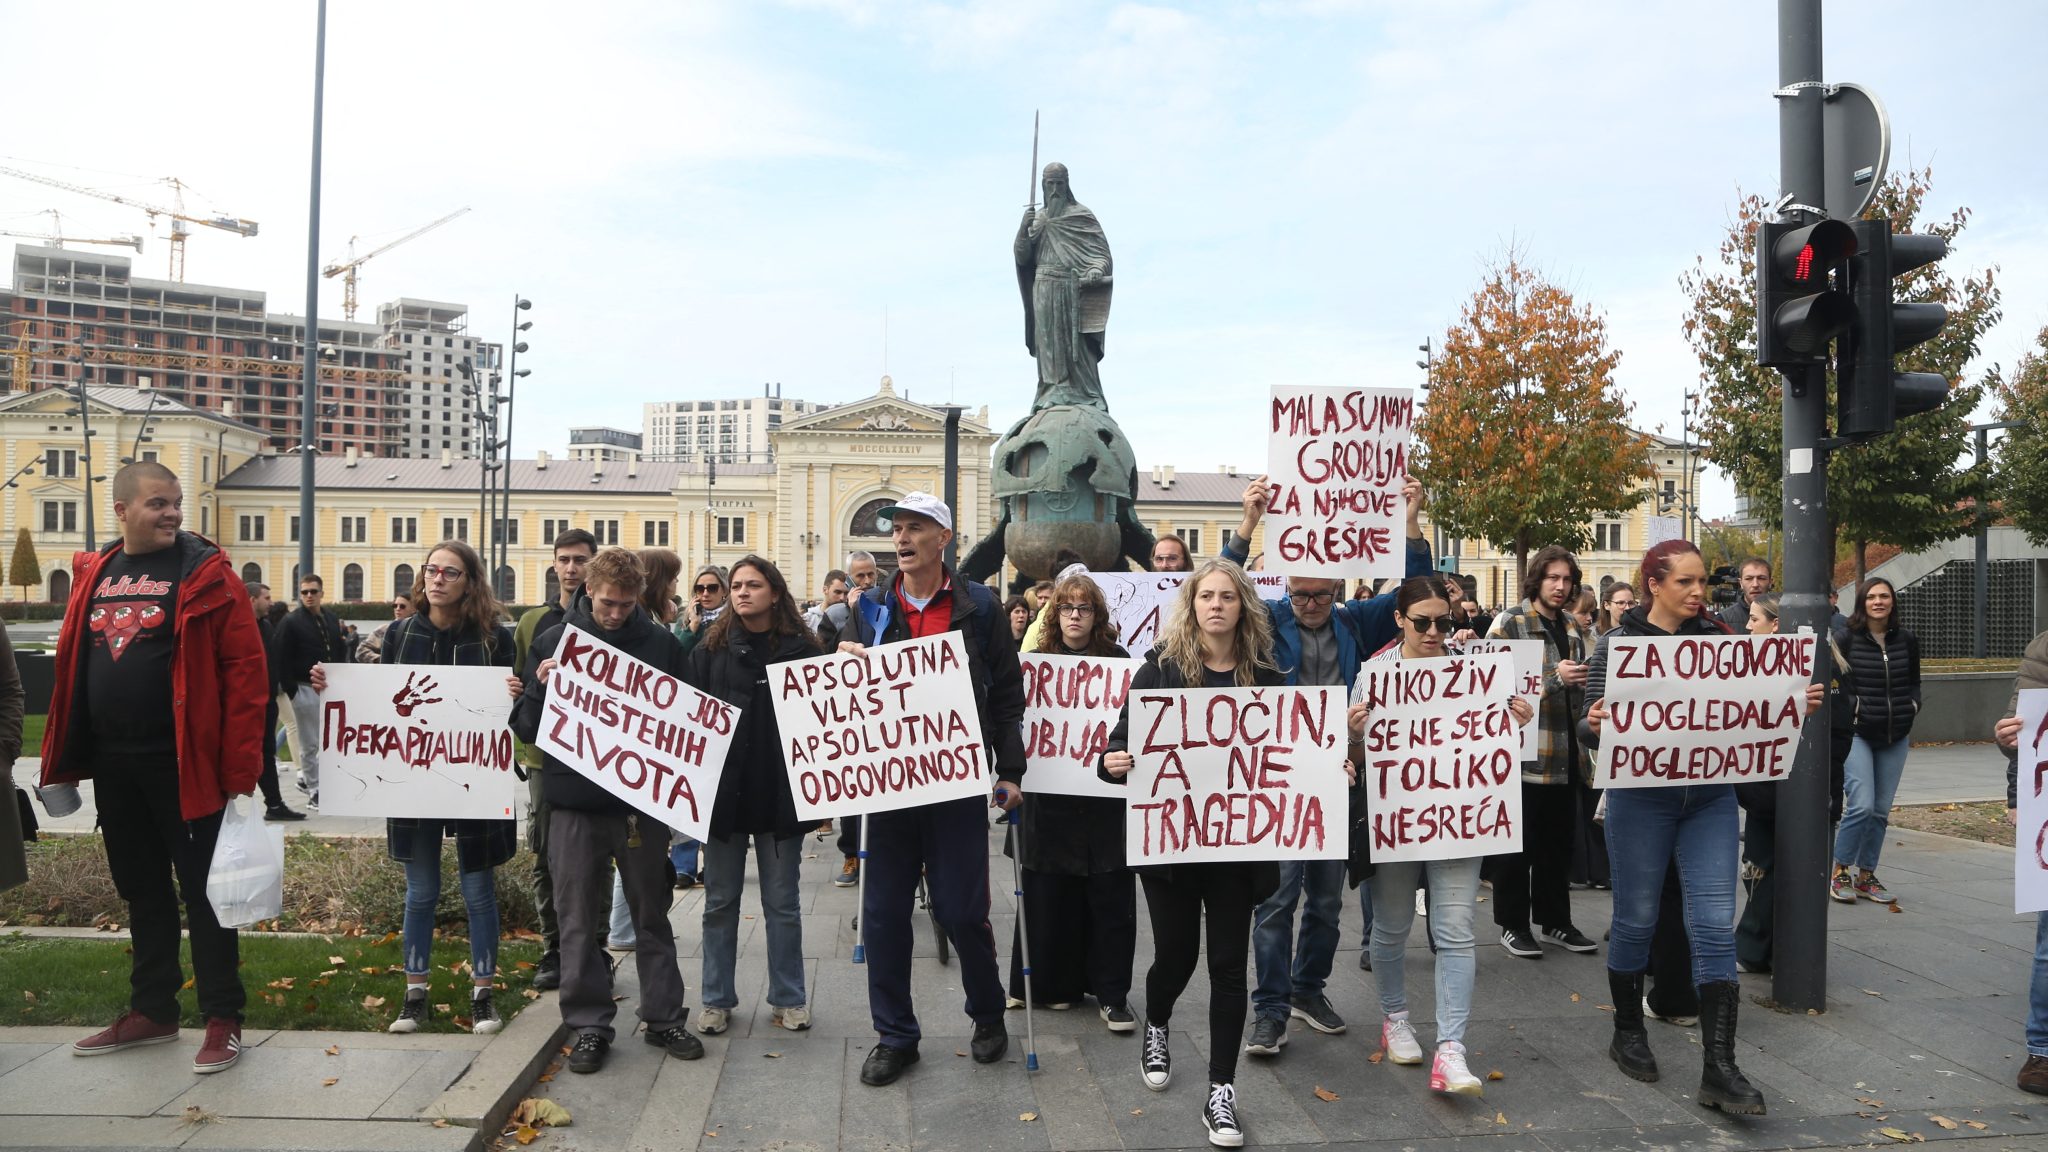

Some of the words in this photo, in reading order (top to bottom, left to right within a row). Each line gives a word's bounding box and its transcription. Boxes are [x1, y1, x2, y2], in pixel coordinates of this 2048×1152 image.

[849, 444, 922, 454] MDCCCLXXXIV
[1266, 483, 1301, 517] ZA
[1279, 520, 1391, 565] GREŠKE
[559, 632, 679, 710] KOLIKO
[686, 690, 735, 736] JOŠ
[782, 639, 960, 701] APSOLUTNA
[1613, 643, 1667, 679] ZA
[1673, 637, 1814, 680] ODGOVORNE
[811, 682, 914, 728] VLAST
[1021, 660, 1132, 711] ORUPCIJ
[554, 671, 708, 767] UNIŠTENIH
[791, 709, 969, 767] APSOLUTNA
[1140, 688, 1336, 756] ZLOČIN,
[1367, 718, 1400, 752] SE
[1409, 717, 1443, 749] NE
[1450, 702, 1512, 741] SEĆA
[1610, 701, 1634, 734] U
[1640, 695, 1800, 732] OGLEDALA
[549, 700, 700, 823] ŽIVOTA
[800, 743, 980, 806] ODGOVORNOST
[1151, 750, 1191, 797] A
[1227, 746, 1294, 791] NE
[1610, 737, 1789, 780] POGLEDAJTE
[1131, 792, 1325, 857] TRAGEDIJA
[1372, 795, 1512, 850] NESREĆA
